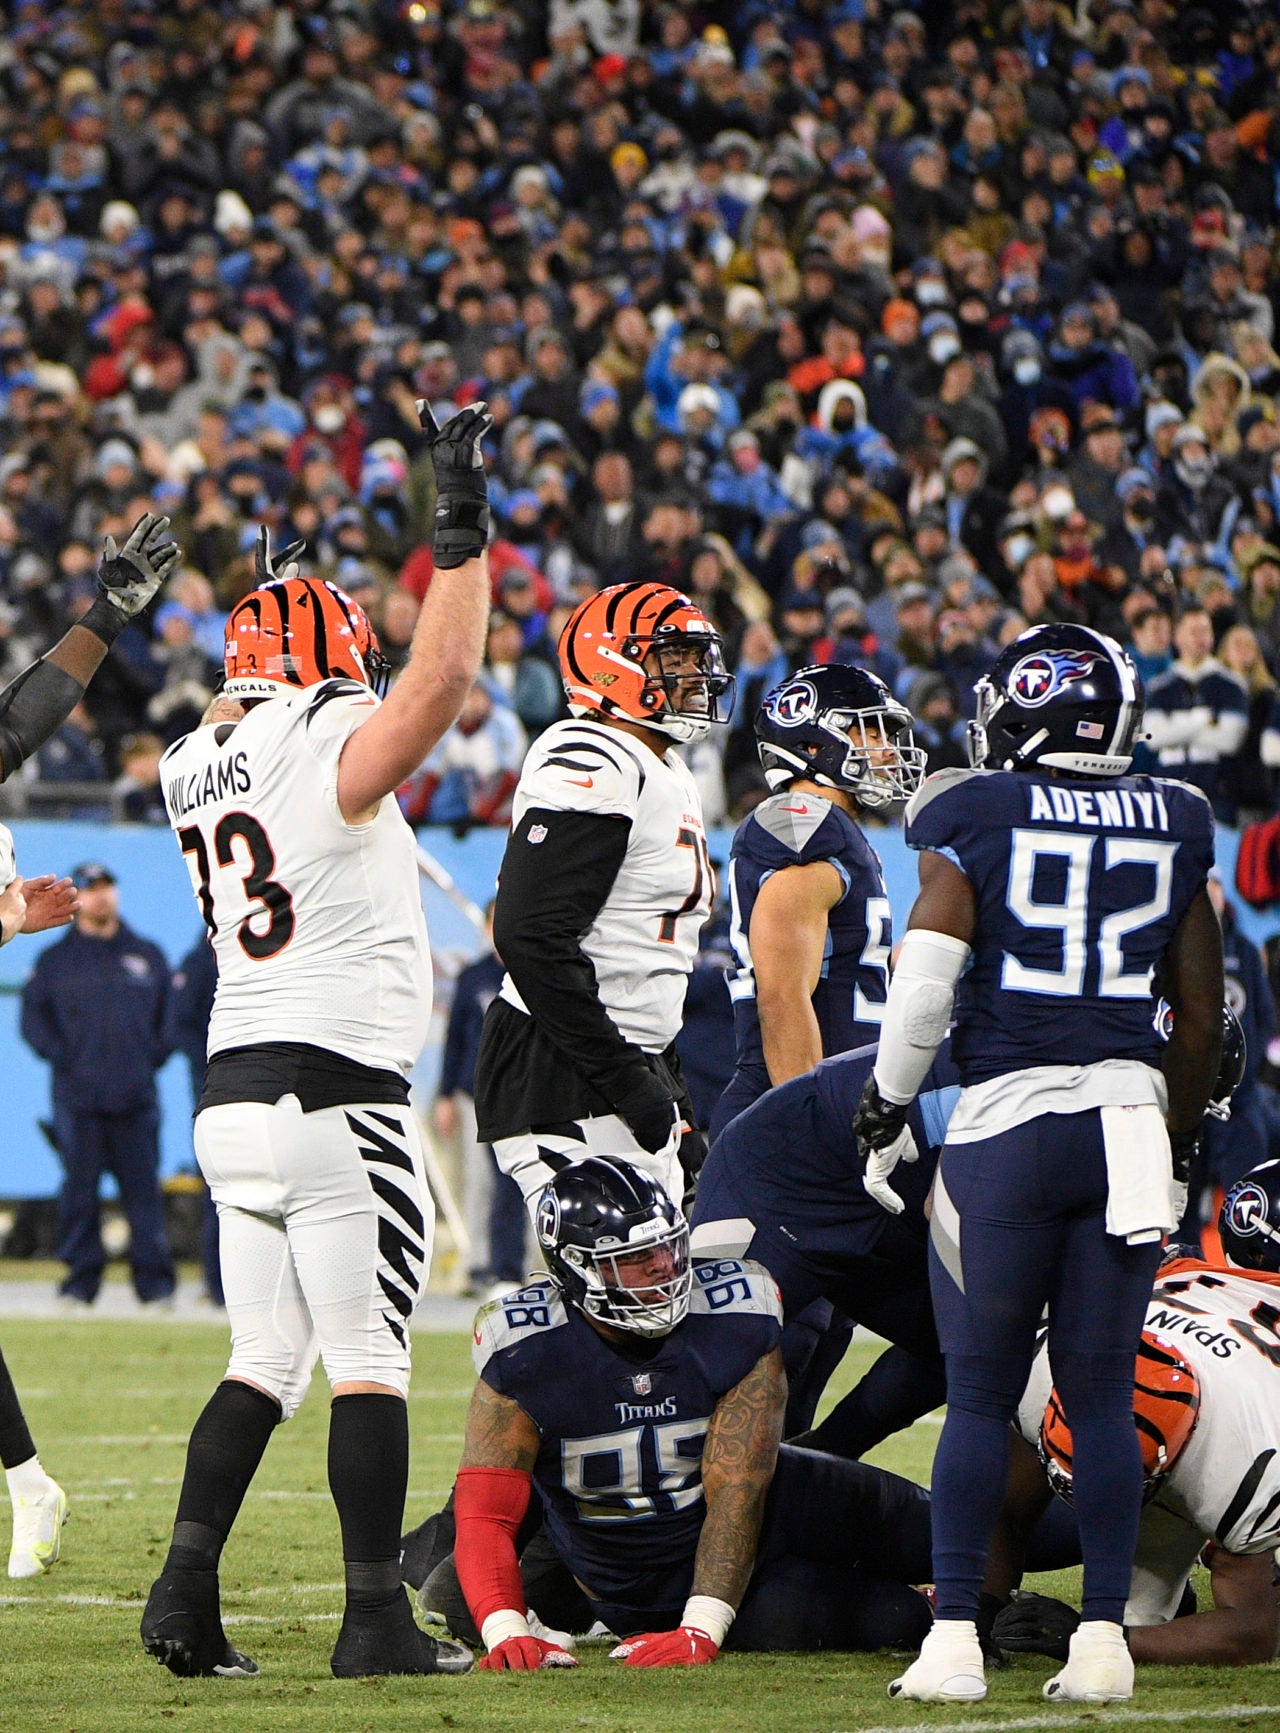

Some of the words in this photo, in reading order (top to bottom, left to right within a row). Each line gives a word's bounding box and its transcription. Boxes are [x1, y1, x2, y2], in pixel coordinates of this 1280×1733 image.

[170, 751, 252, 821] WILLIAMS
[1030, 784, 1169, 832] ADENIYI
[178, 810, 296, 966] 73
[1000, 827, 1182, 999] 92
[1145, 1309, 1242, 1359] SPAIN
[614, 1395, 678, 1425] TITANS
